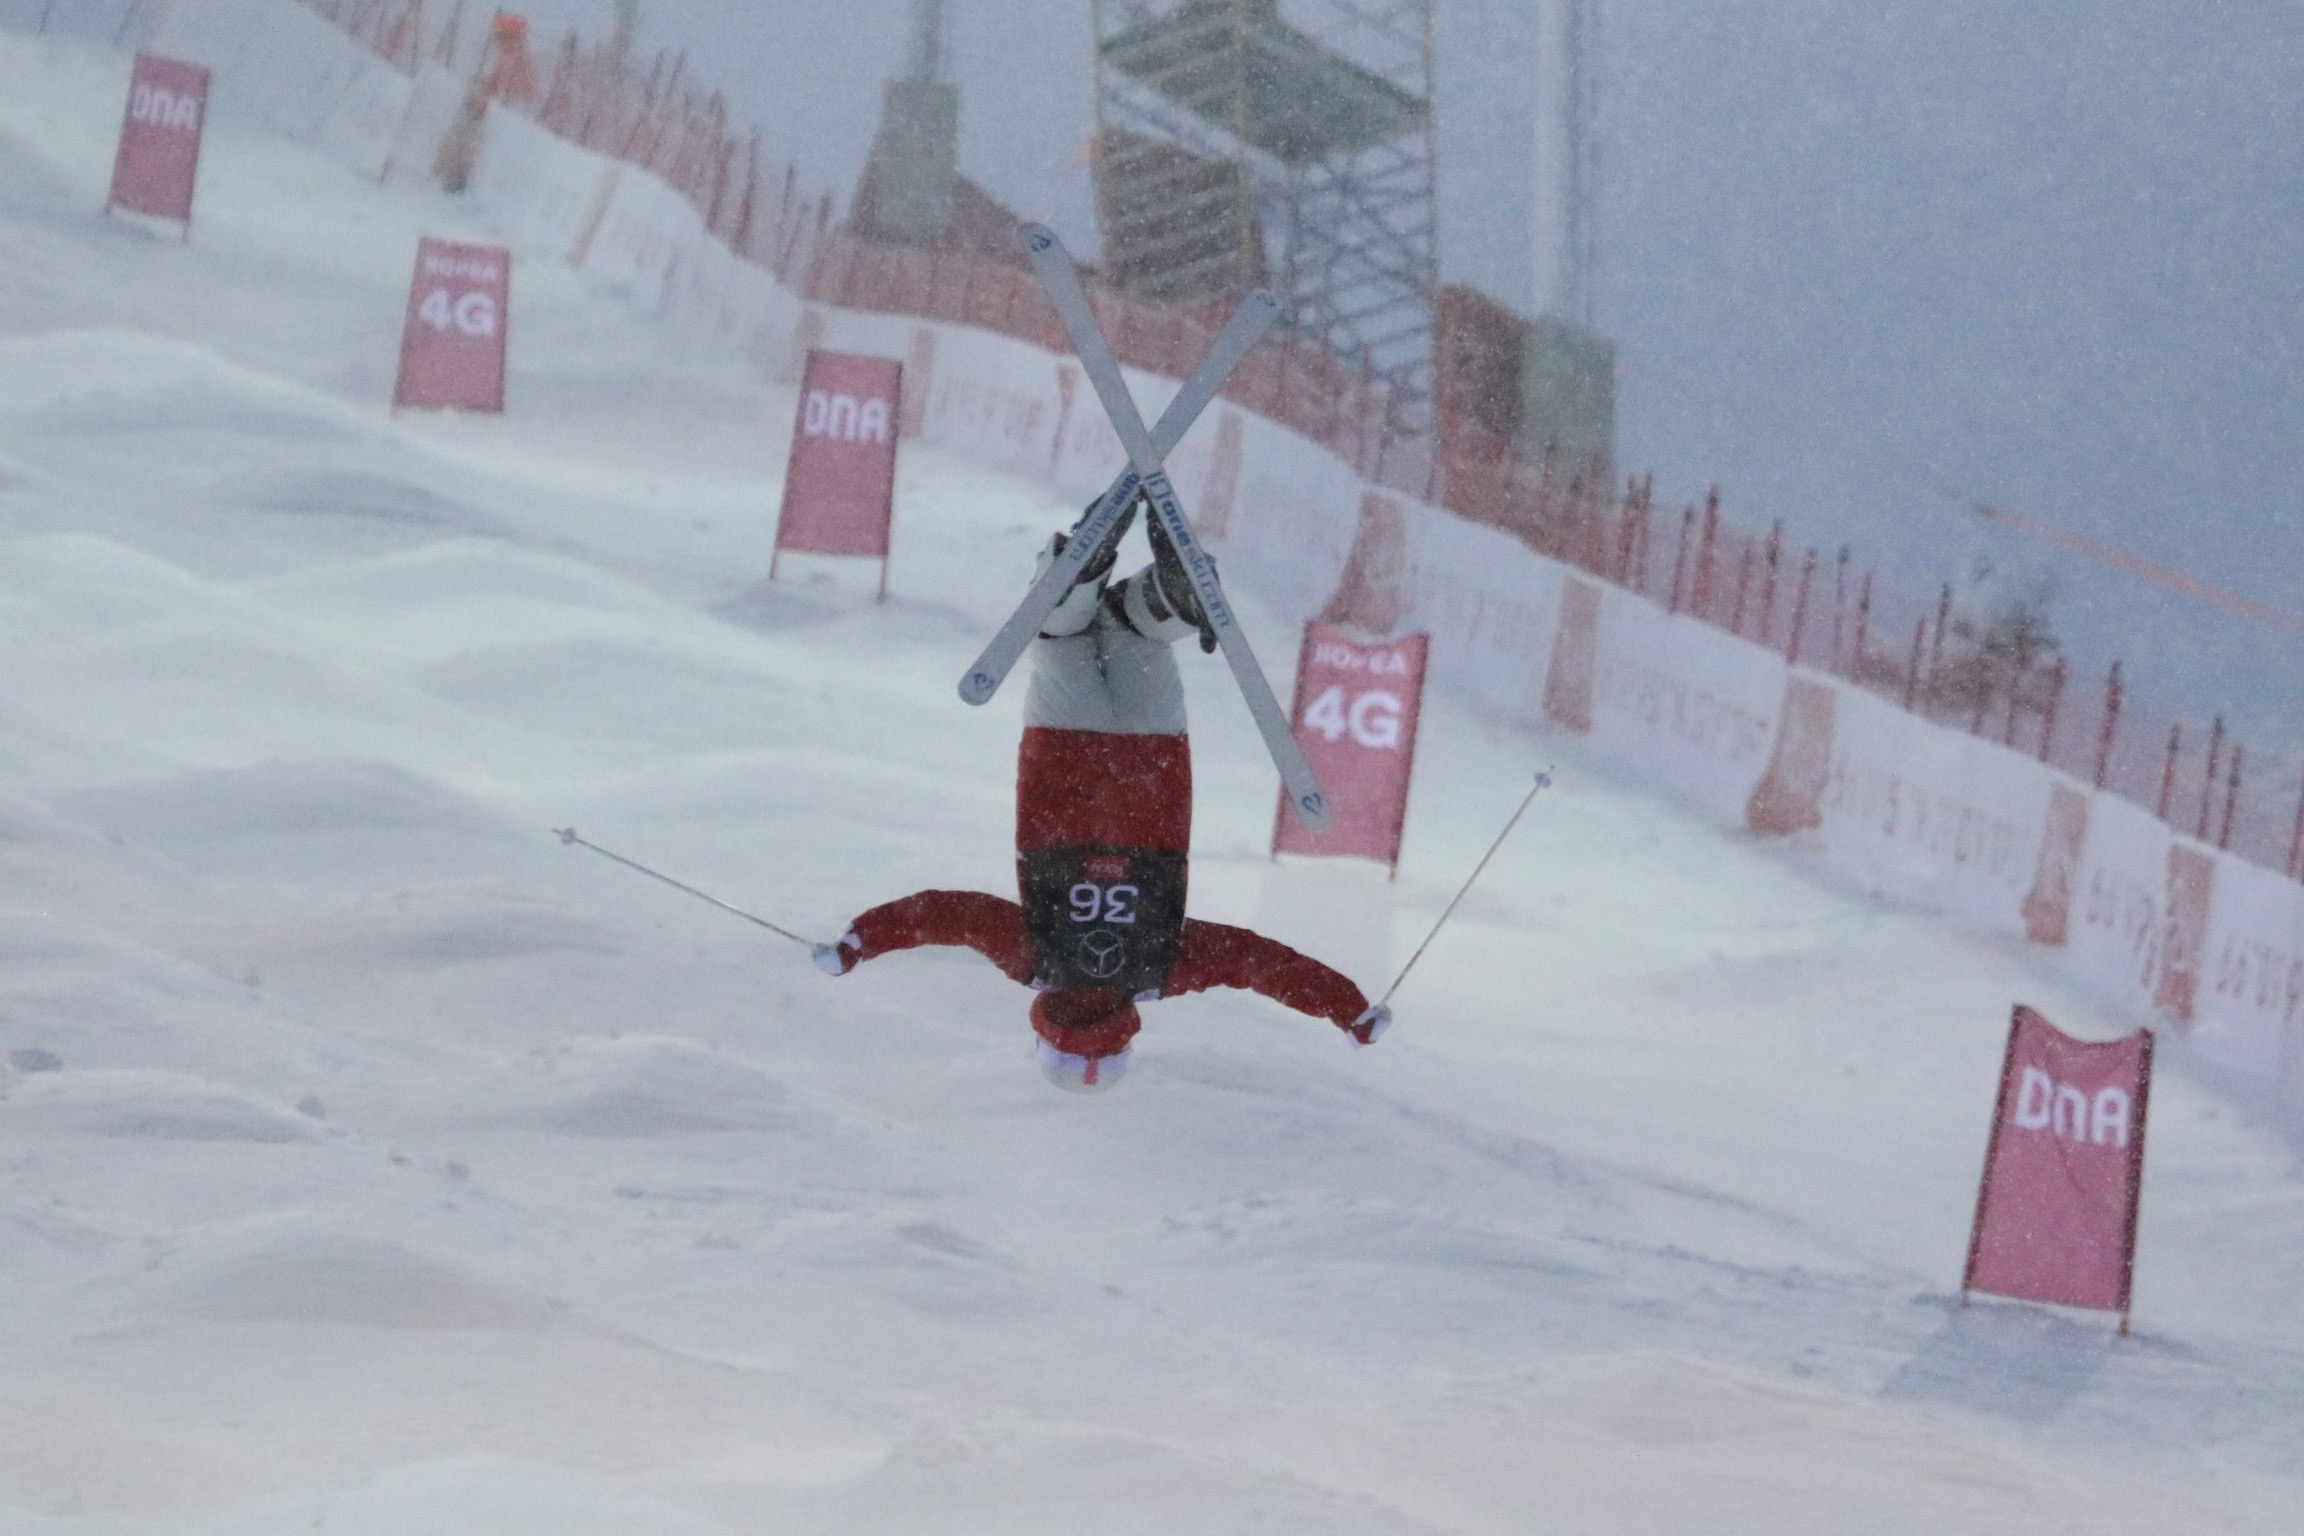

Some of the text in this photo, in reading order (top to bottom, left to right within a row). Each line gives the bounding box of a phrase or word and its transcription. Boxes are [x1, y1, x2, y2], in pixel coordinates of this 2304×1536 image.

[419, 288, 497, 337] 4G
[1303, 686, 1402, 749] 4G
[1068, 883, 1139, 923] 36
